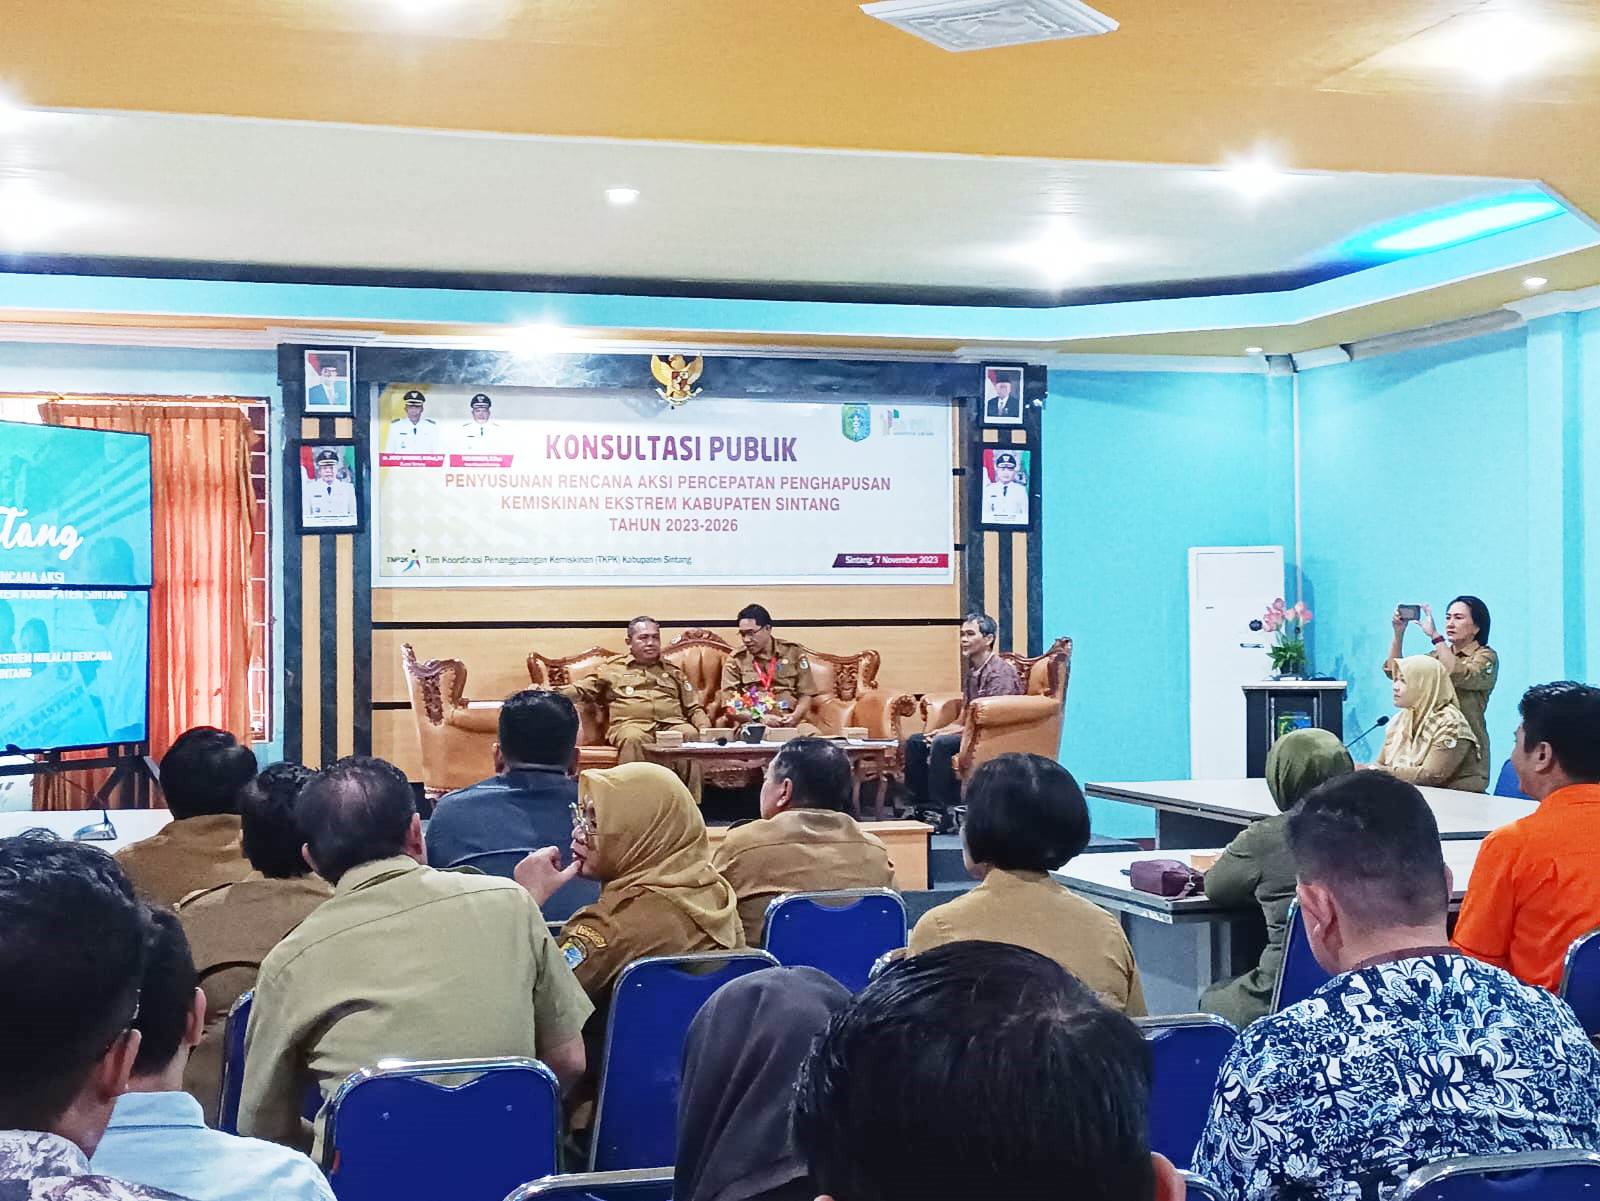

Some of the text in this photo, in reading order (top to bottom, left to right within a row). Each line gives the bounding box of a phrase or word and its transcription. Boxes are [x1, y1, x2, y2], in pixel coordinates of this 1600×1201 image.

[546, 435, 797, 462] KONSULTASI PUBLIK
[445, 473, 891, 491] PENYUSUNAN RENCANA AKSI PERCEPATAN PENGHAPUSAN
[501, 495, 840, 511] KEMISKINAN EKSTREM KABUPATEN SINTANG
[610, 518, 738, 532] TAHUN 2023-2026
[425, 555, 440, 564] Tim
[441, 555, 481, 564] Koordinasi
[549, 555, 593, 564] Kemiskinan
[595, 555, 621, 565] (TKPK)
[622, 555, 663, 565] Kabupaten
[663, 555, 692, 566] Sintang
[844, 555, 939, 566] Sintang, 7 November 2023
